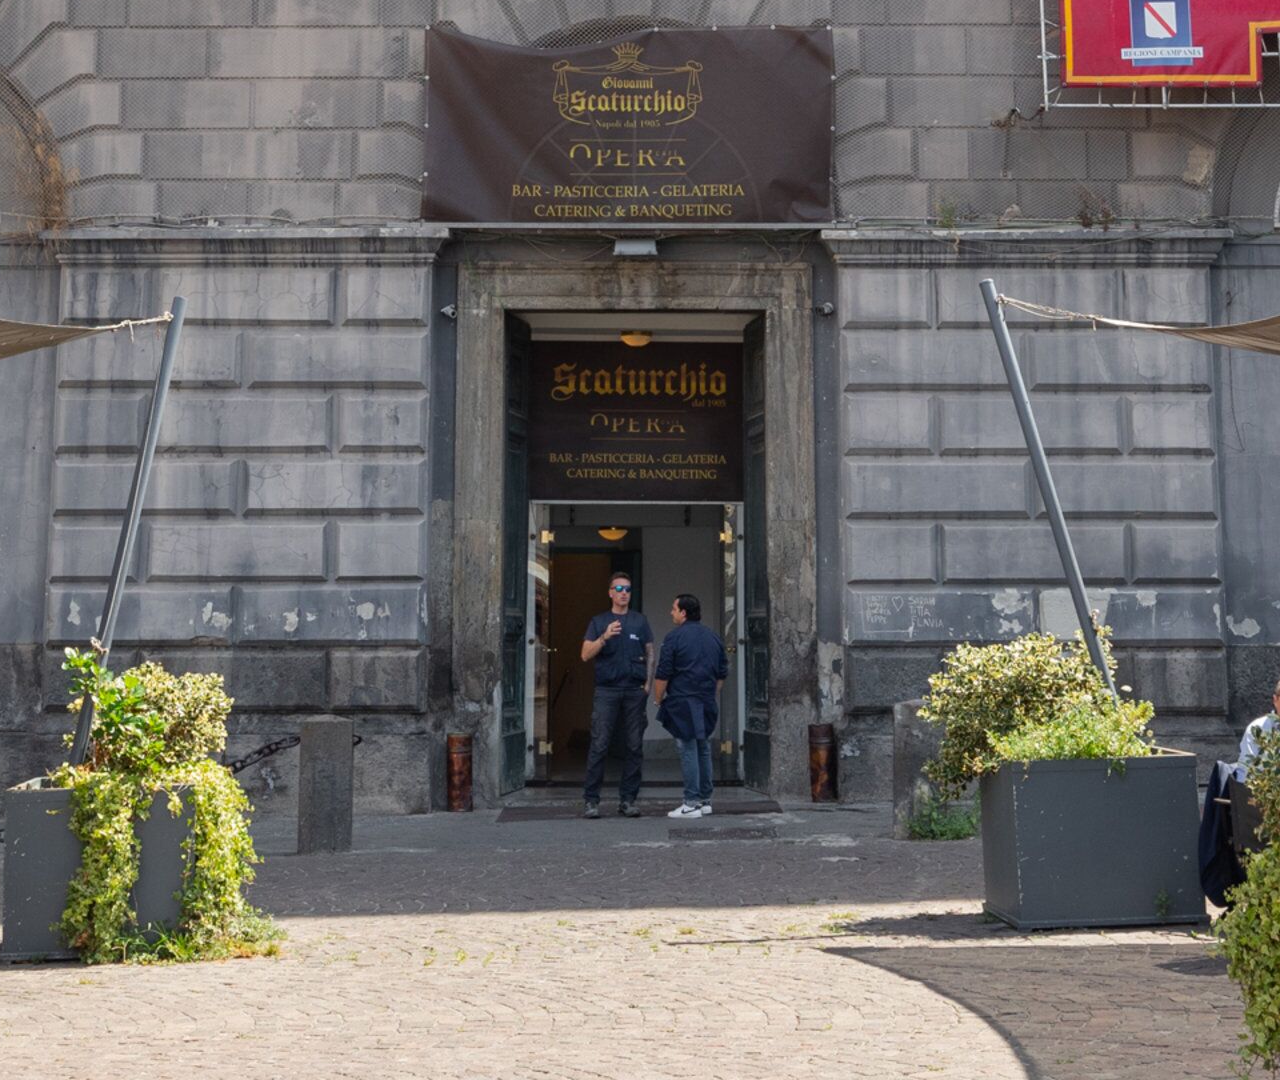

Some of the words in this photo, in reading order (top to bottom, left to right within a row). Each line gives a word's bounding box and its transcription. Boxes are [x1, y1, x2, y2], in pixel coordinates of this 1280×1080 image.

[1123, 49, 1157, 58] REGIONE
[1159, 48, 1201, 57] CAMPANIA
[602, 76, 654, 89] Giovanni
[570, 89, 687, 117] Scaturchio
[623, 119, 637, 129] dal
[570, 143, 686, 167] OPERA
[512, 184, 543, 197] BAR
[553, 184, 650, 198] PASTICCERIA
[660, 183, 745, 198] GELATERIA
[534, 204, 612, 218] CATERING
[614, 204, 627, 218] &
[629, 203, 733, 219] BANQUETING
[551, 362, 728, 402] Scaturchio
[590, 413, 687, 434] OPERA
[549, 453, 574, 464] BAR
[581, 453, 655, 465] PASTICCERIA
[663, 453, 728, 465] GELATERIA
[566, 469, 625, 480] CATERING
[626, 469, 638, 480] &
[639, 469, 718, 481] BANQUETING
